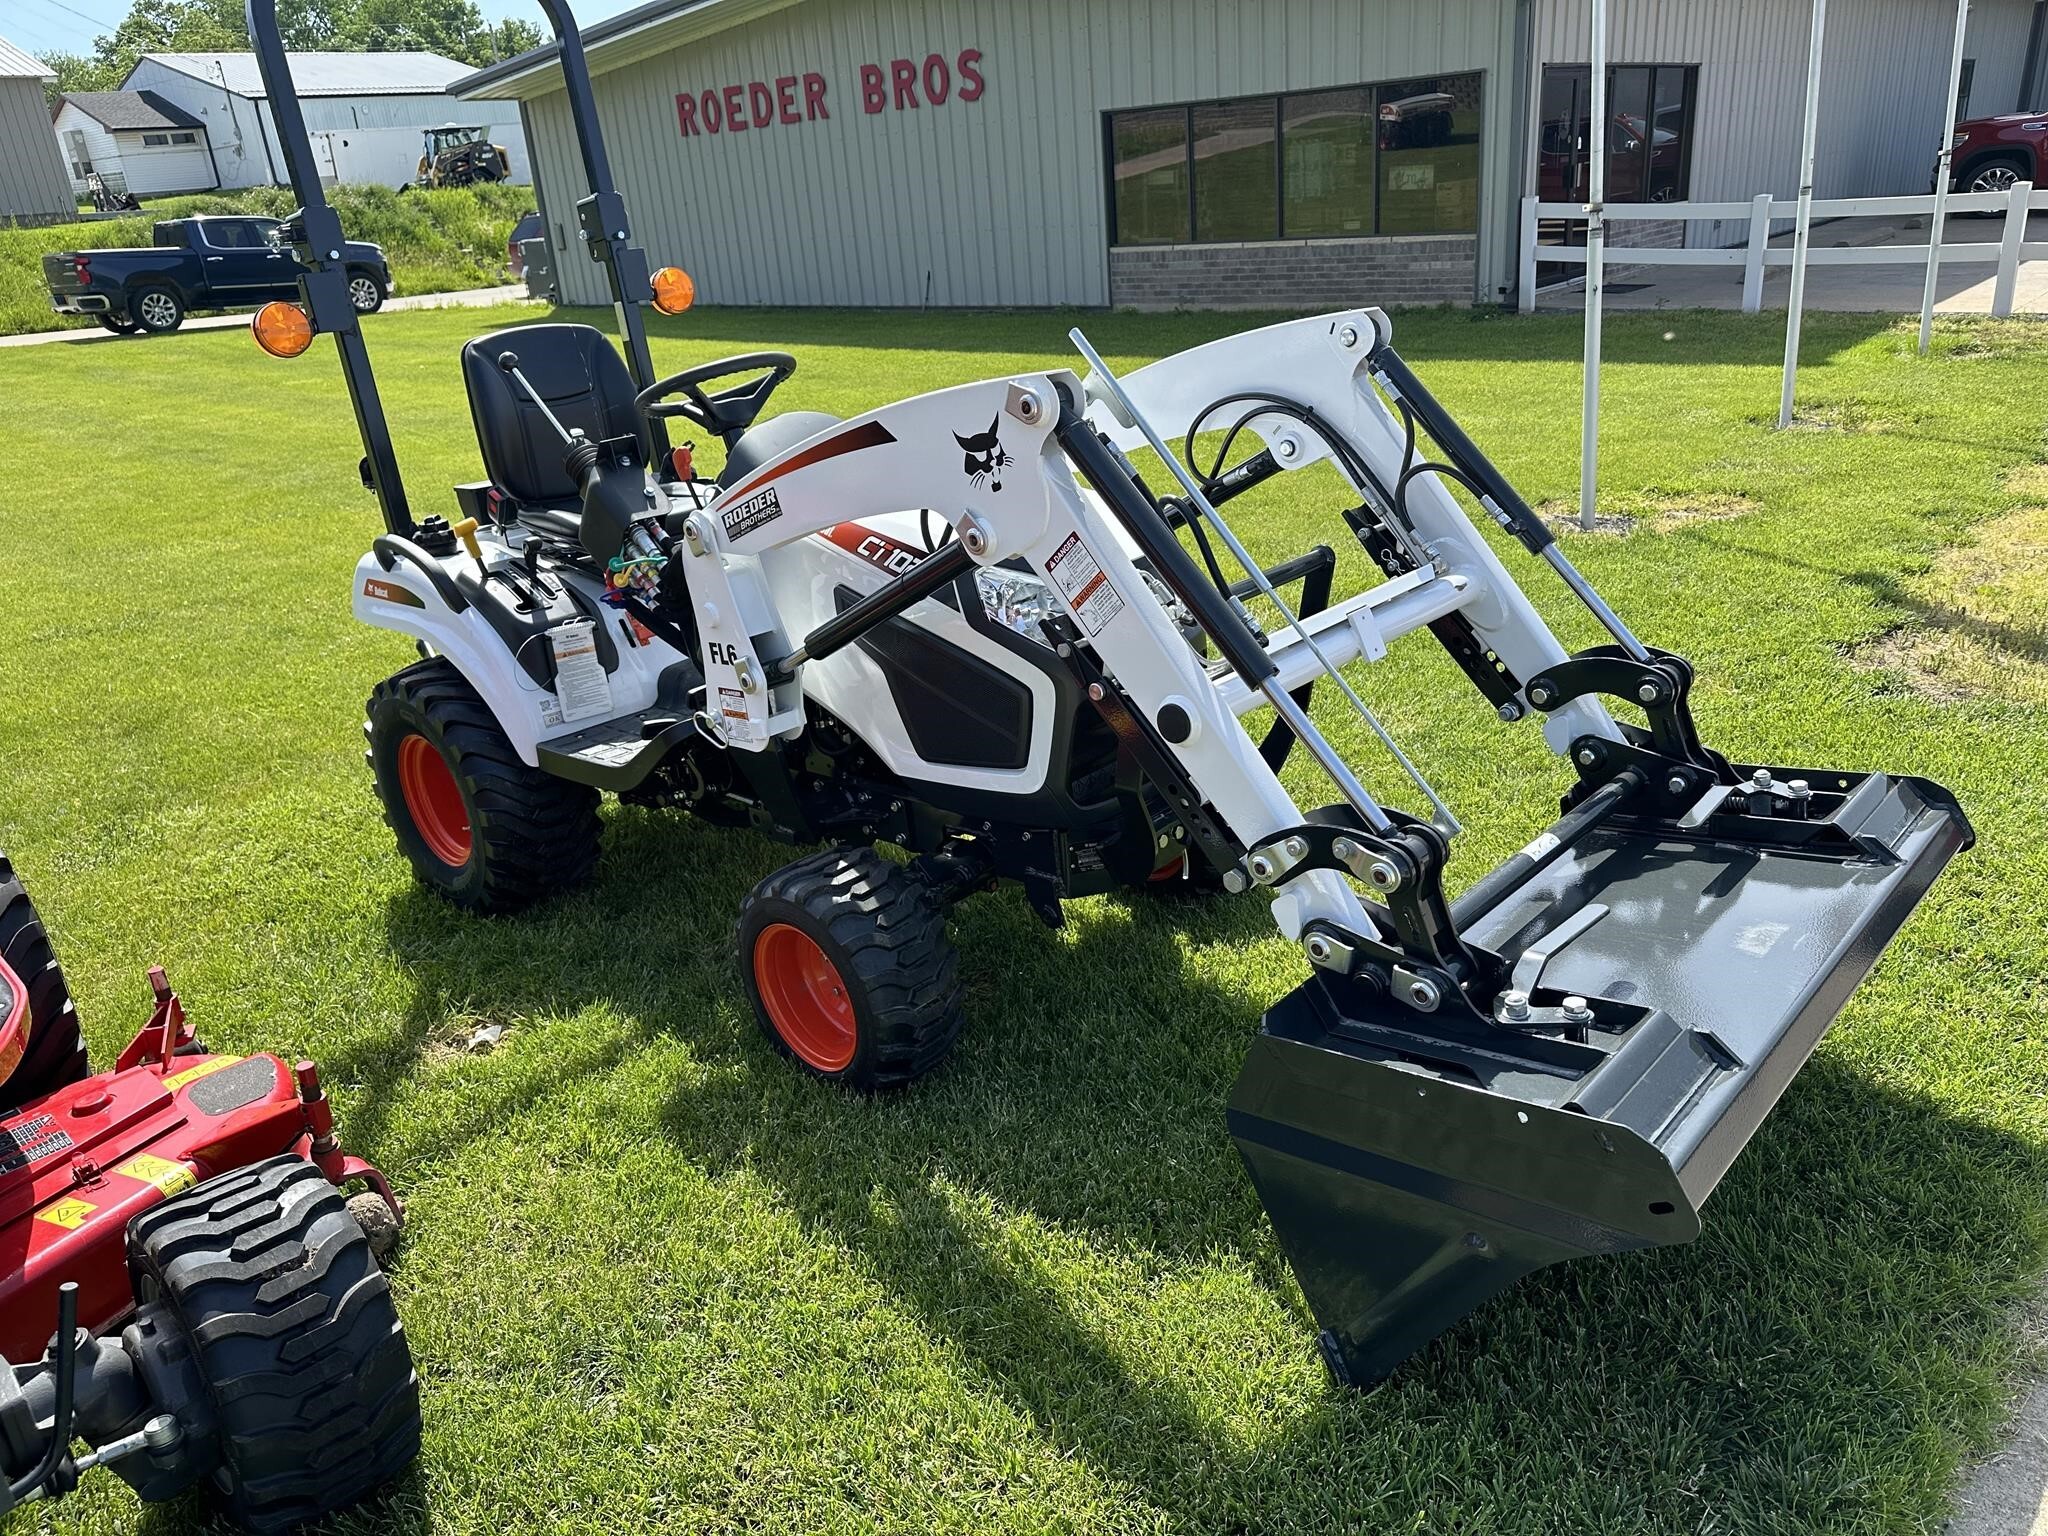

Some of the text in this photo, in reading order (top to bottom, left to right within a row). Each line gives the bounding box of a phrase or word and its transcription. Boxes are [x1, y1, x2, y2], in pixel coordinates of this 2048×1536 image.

[675, 48, 985, 137] ROEDER BROS
[724, 489, 776, 528] ROEDER
[740, 504, 776, 530] BROTHERS
[1053, 536, 1077, 563] DANGER
[1079, 575, 1103, 604] WARNING
[709, 642, 738, 666] FL6
